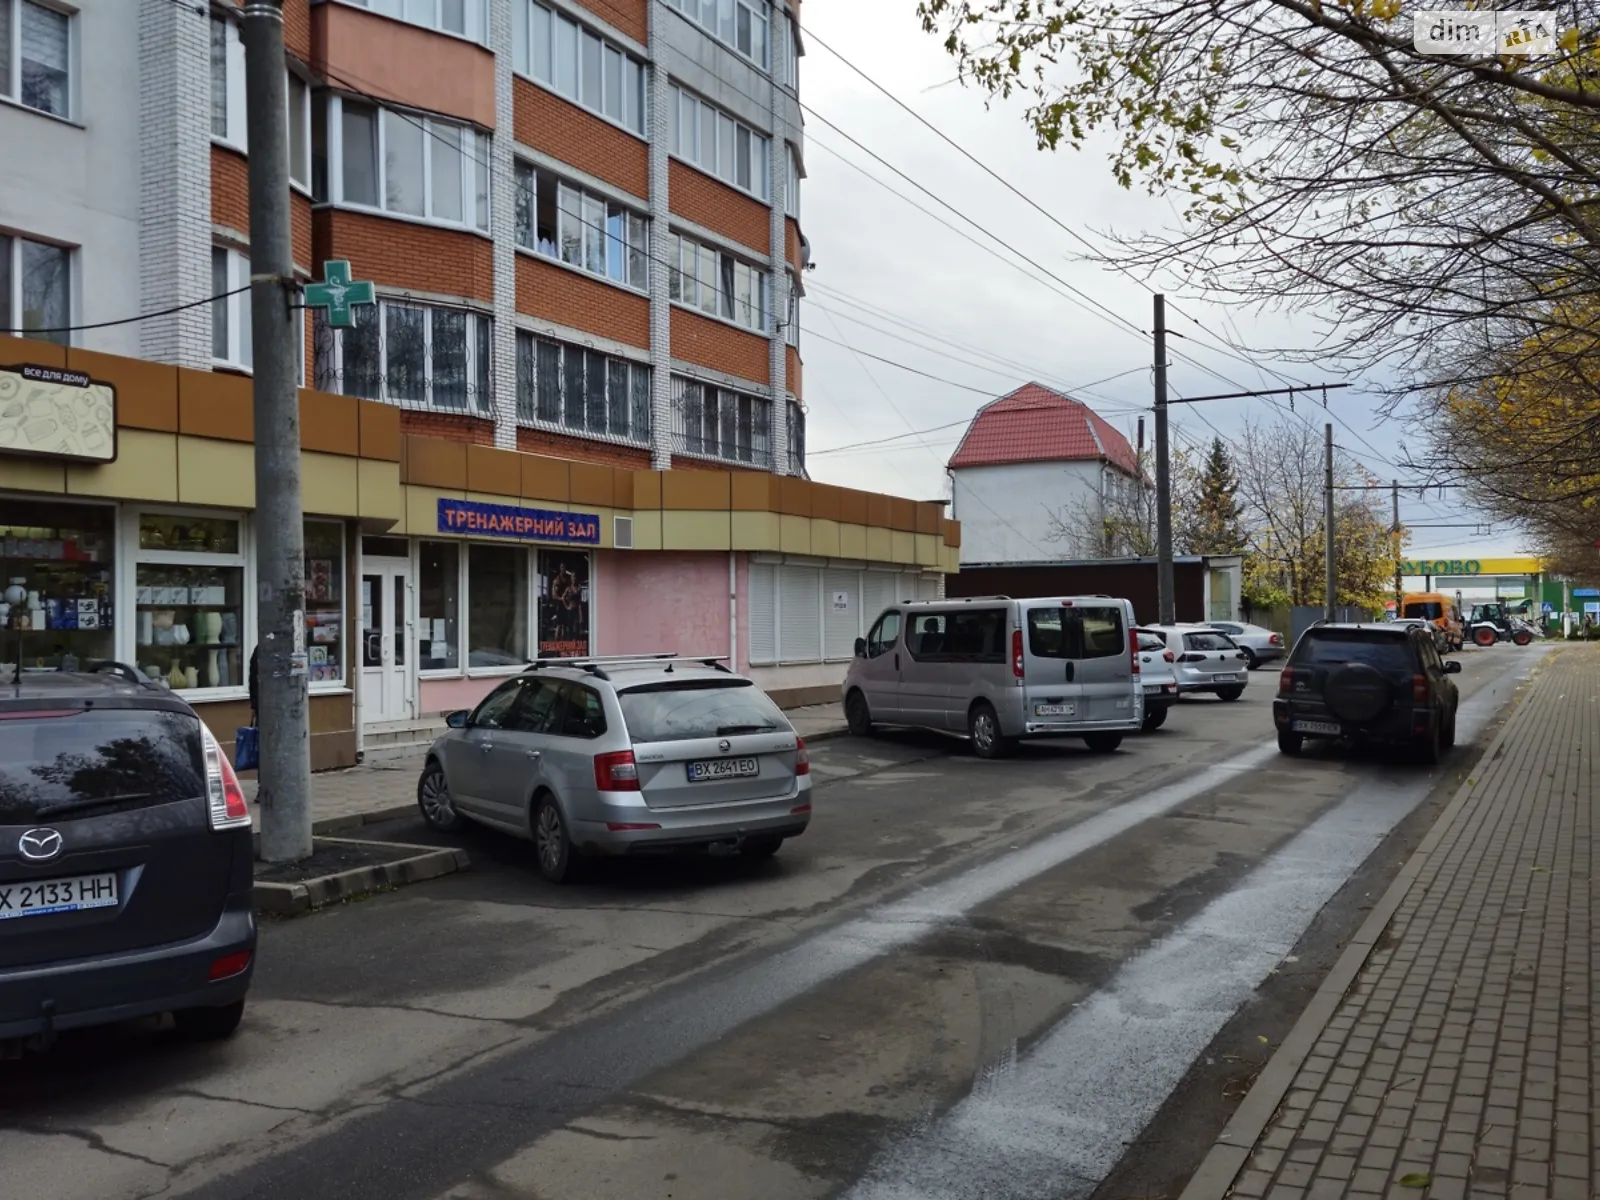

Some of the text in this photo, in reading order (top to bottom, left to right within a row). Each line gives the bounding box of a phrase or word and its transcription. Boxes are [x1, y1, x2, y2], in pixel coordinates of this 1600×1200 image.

[24, 367, 88, 386] все для дому
[445, 509, 595, 538] ТРЕНАЖЕРНИЙ ЗАЛ
[1400, 560, 1481, 575] УБОВО
[714, 760, 737, 774] 2641
[20, 882, 73, 908] 2133
[79, 877, 113, 900] HH
